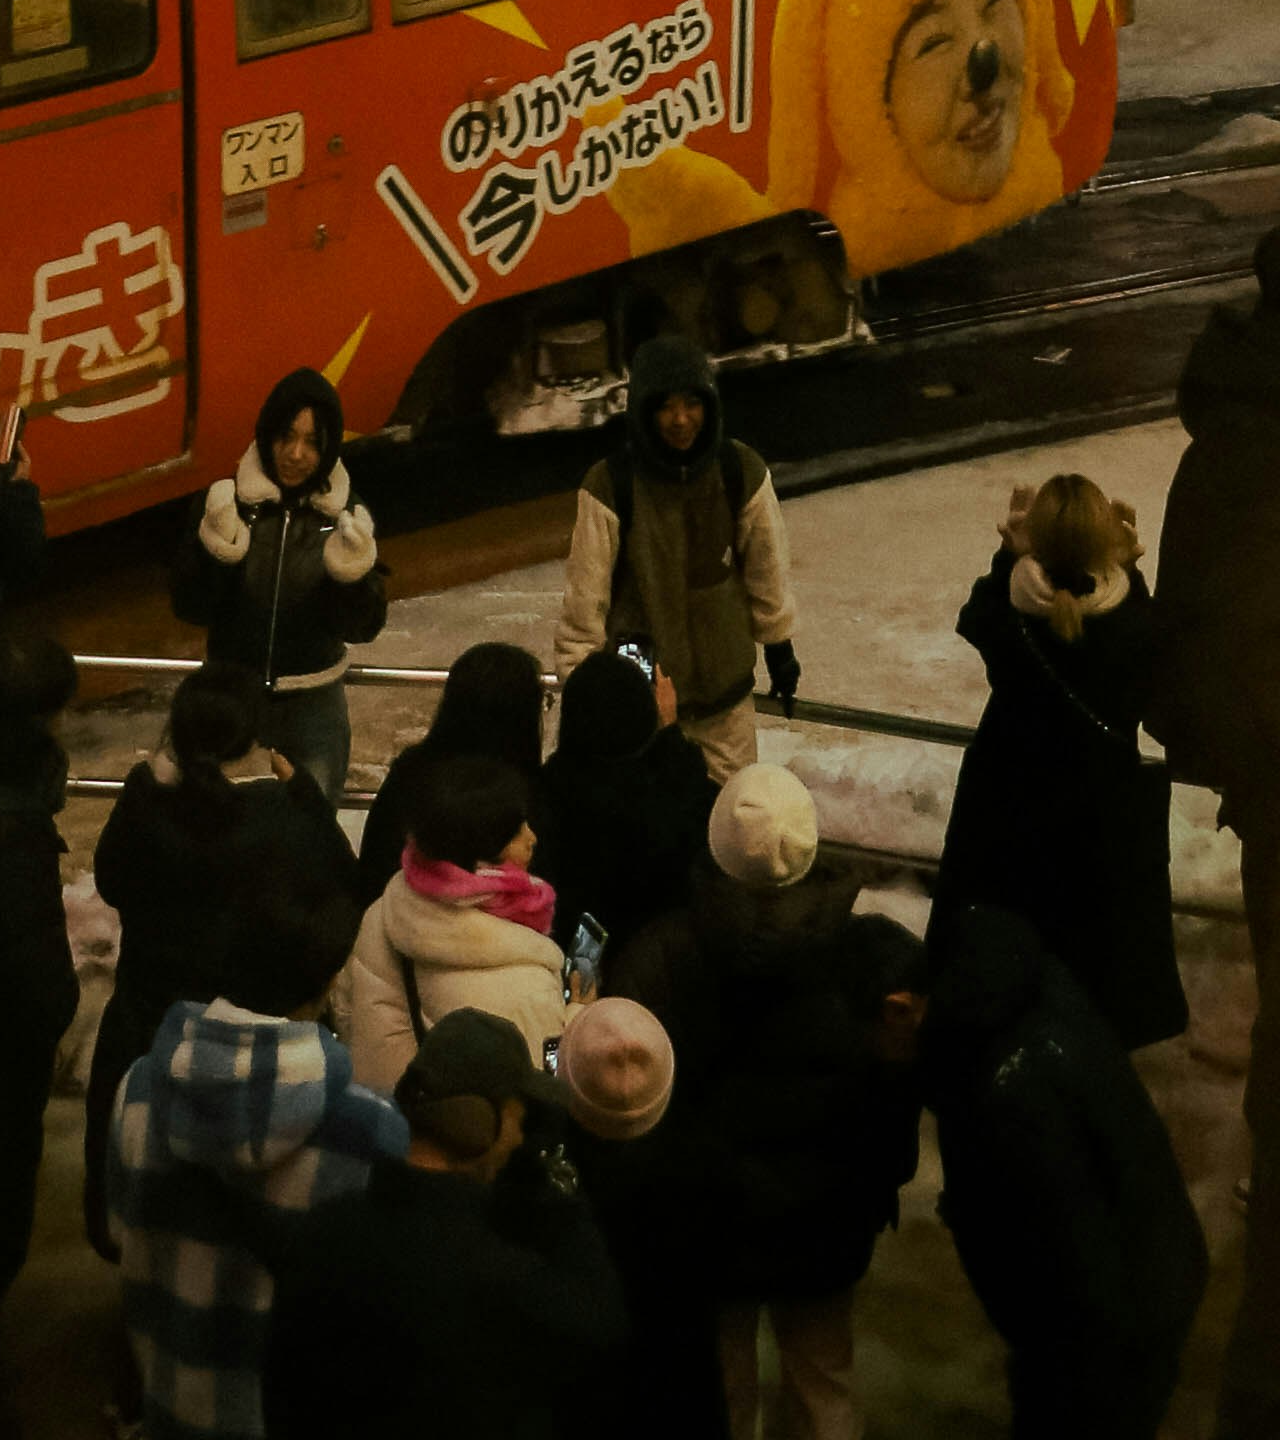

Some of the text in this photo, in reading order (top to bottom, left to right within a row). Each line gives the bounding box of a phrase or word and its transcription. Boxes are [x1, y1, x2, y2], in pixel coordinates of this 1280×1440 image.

[445, 2, 712, 165] のりかえるなら
[226, 122, 299, 155] ワンマン
[240, 154, 288, 186] 入口
[462, 67, 720, 270] 今しかない!
